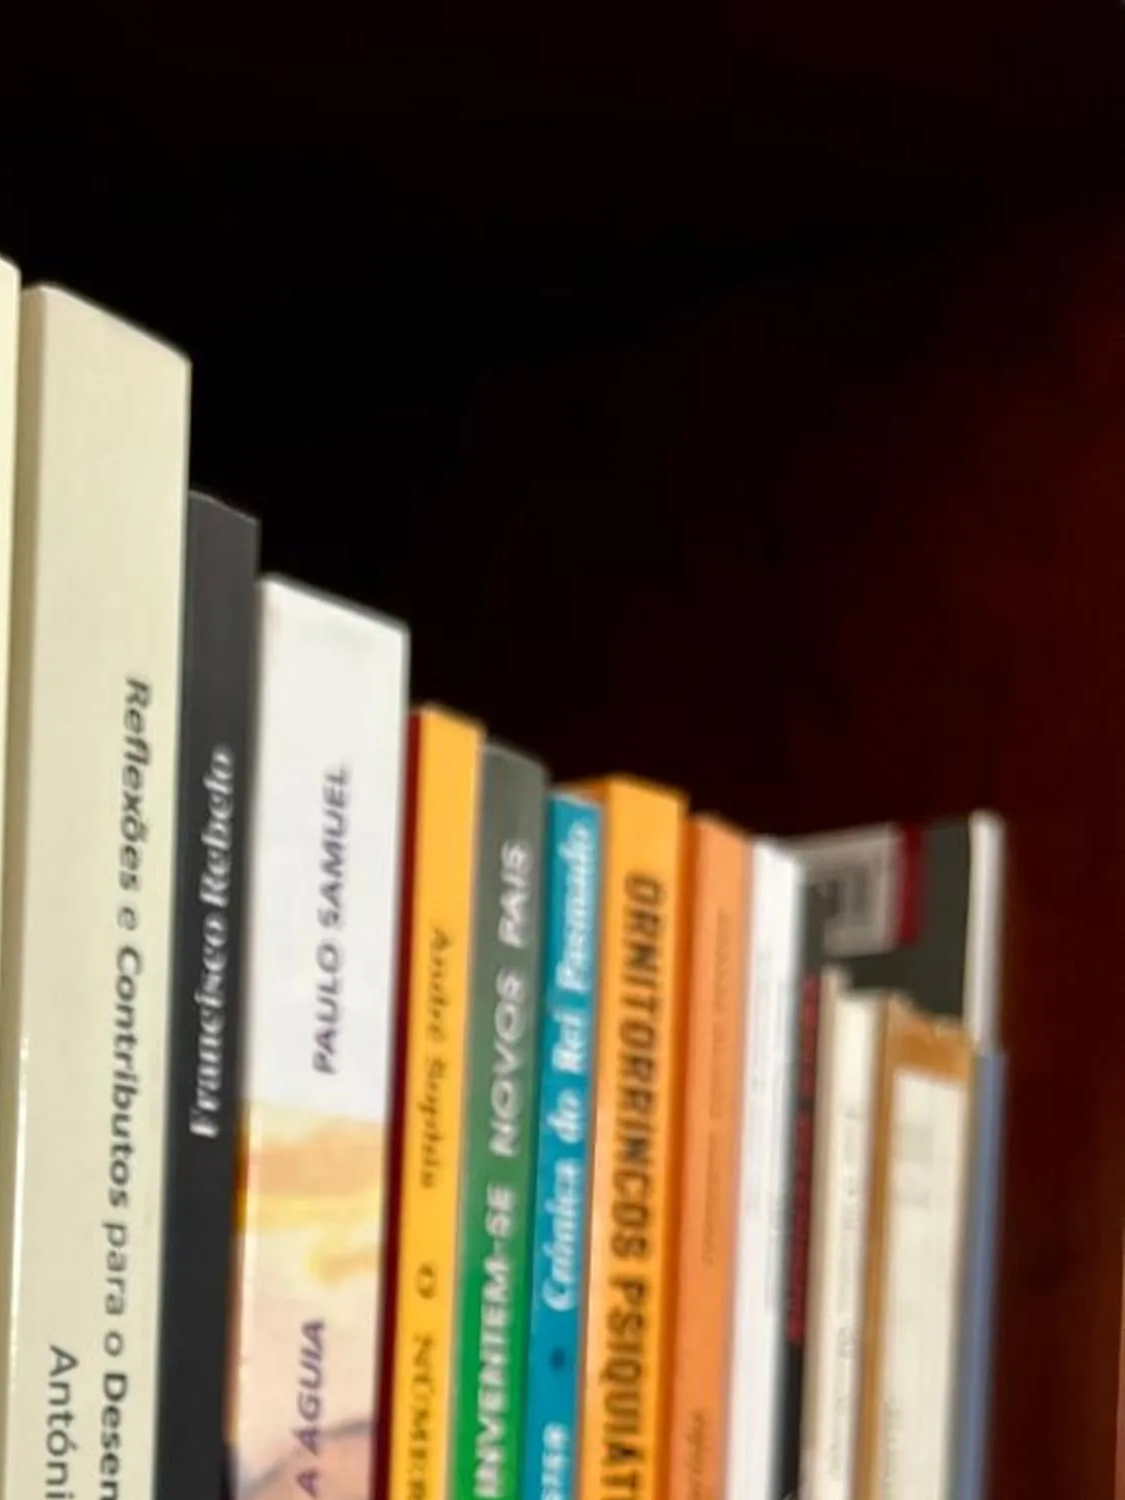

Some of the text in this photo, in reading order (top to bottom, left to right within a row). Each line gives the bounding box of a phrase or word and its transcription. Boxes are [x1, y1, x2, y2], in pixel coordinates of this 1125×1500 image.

[118, 674, 152, 893] Reflexões
[117, 906, 138, 931] e
[189, 743, 233, 1138] Francisco Rebelo
[313, 766, 350, 1075] PAULO SAMUEL
[106, 945, 143, 1210] Contributos
[546, 1088, 583, 1144] do
[551, 1008, 586, 1073] Rei
[610, 870, 665, 1260] ORNITORRINCOS
[474, 840, 529, 1498] INVENTEM-SE NOVOS PAIS
[102, 1220, 129, 1317] para
[104, 1331, 124, 1357] o
[296, 1472, 318, 1497] A
